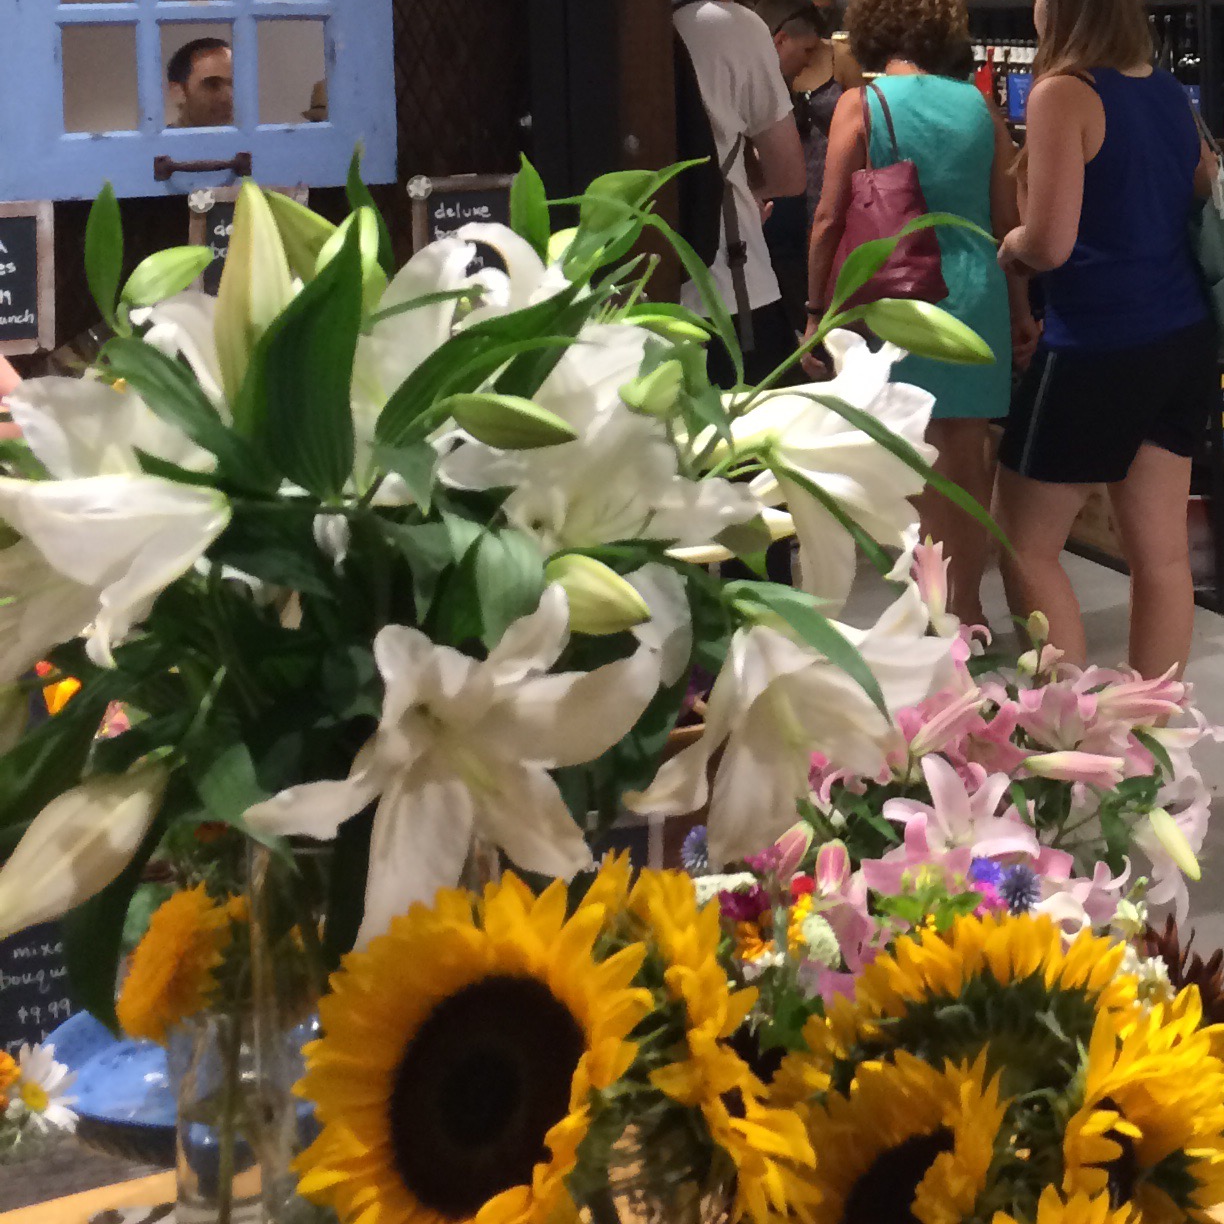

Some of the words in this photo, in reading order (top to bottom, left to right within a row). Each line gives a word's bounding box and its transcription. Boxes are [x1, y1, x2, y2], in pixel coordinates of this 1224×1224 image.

[434, 202, 492, 219] deluxe
[0, 308, 35, 325] unch
[13, 942, 64, 959] mixe
[0, 966, 68, 995] bouque
